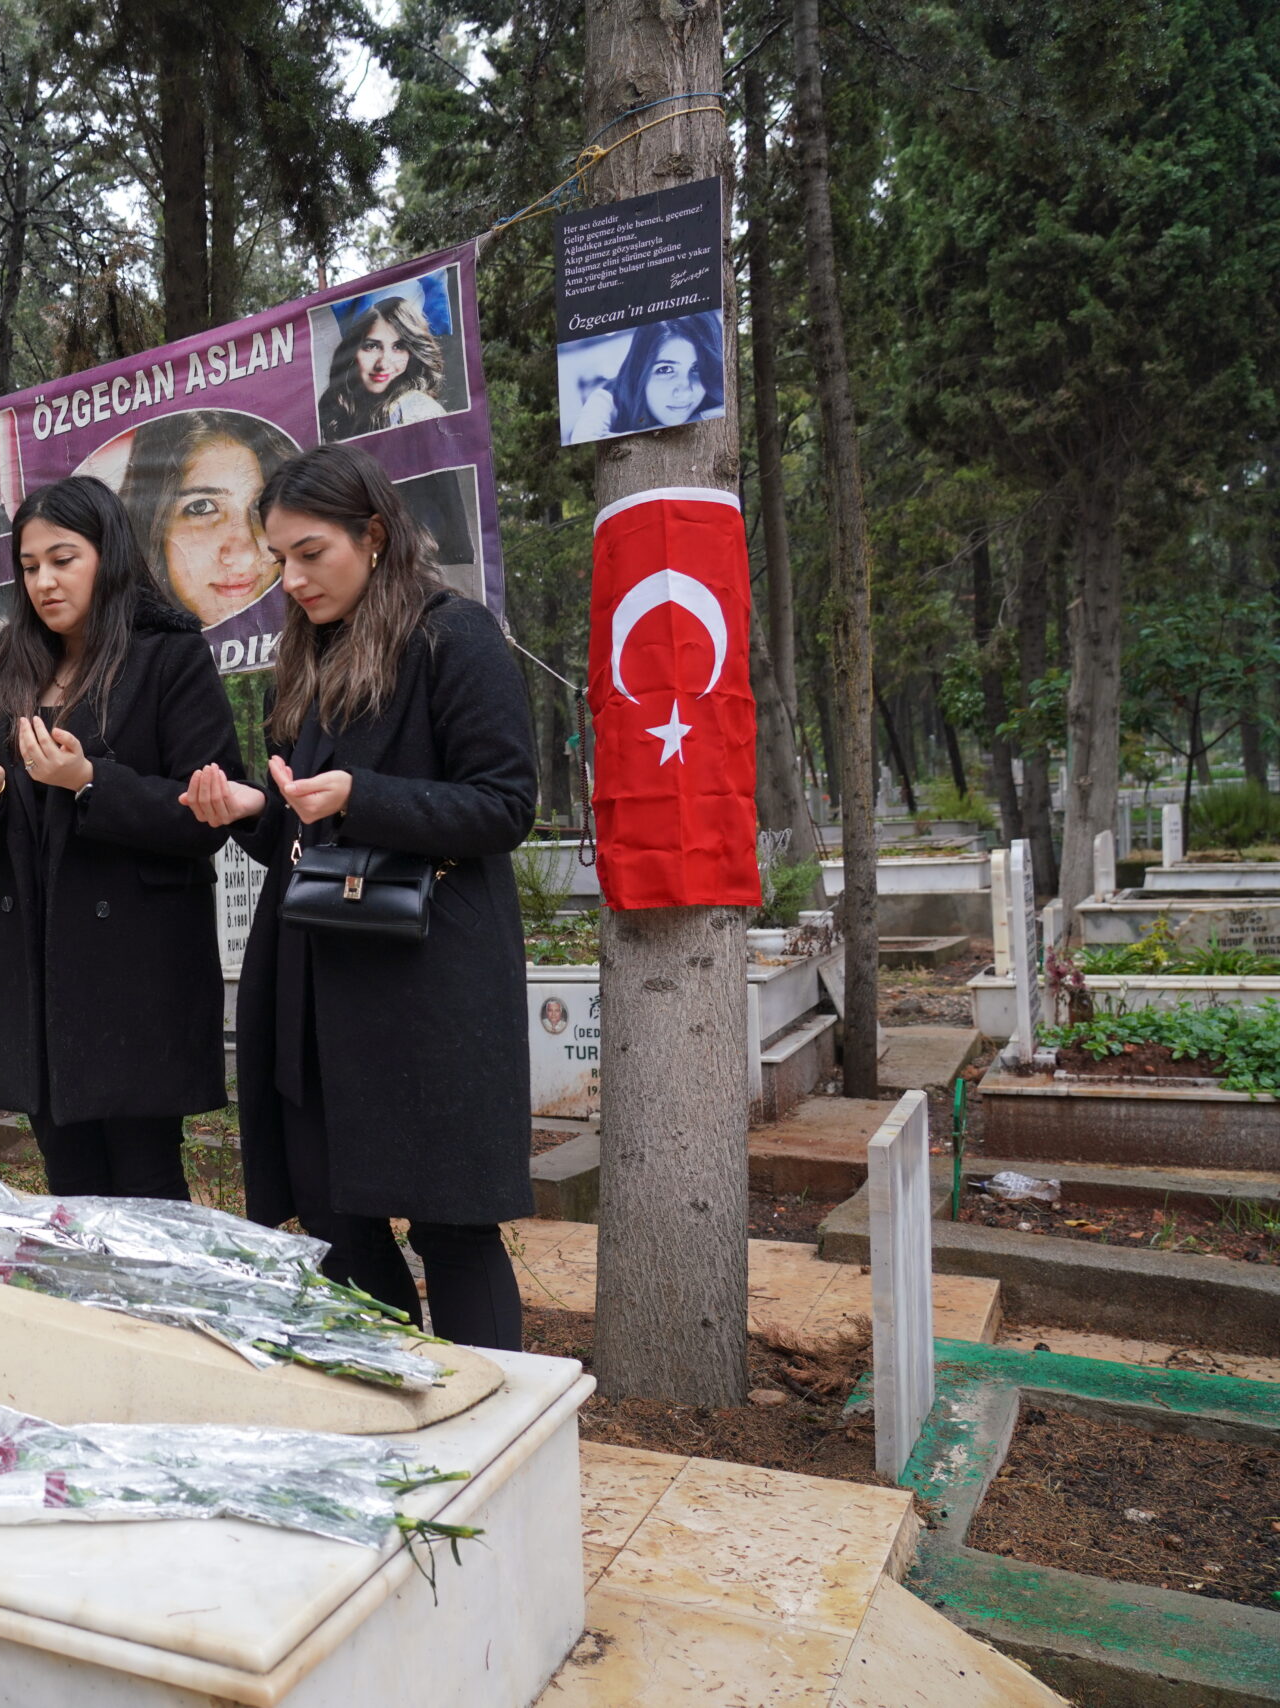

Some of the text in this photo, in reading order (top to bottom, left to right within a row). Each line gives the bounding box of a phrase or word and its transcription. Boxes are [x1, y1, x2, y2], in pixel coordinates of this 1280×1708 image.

[563, 235, 585, 245] Gelip
[586, 227, 616, 241] geçmez
[616, 222, 634, 233] öyle
[665, 203, 703, 223] geçemez!
[563, 215, 619, 235] Her acı özeldir
[564, 241, 602, 256] Ağladıkça
[564, 236, 663, 266] Akıp gitmez gözyaşlarıyla
[565, 243, 682, 276] Bulaşmaz elini sürünce gözüne
[565, 246, 712, 287] Ama yüreğine bulaşır insanın ve yakar
[565, 286, 596, 297] Kavurur
[647, 291, 710, 313] anısına...
[32, 322, 295, 441] ÖZGECAN ASLAN
[209, 631, 284, 671] DIK
[224, 871, 246, 889] BAYAR
